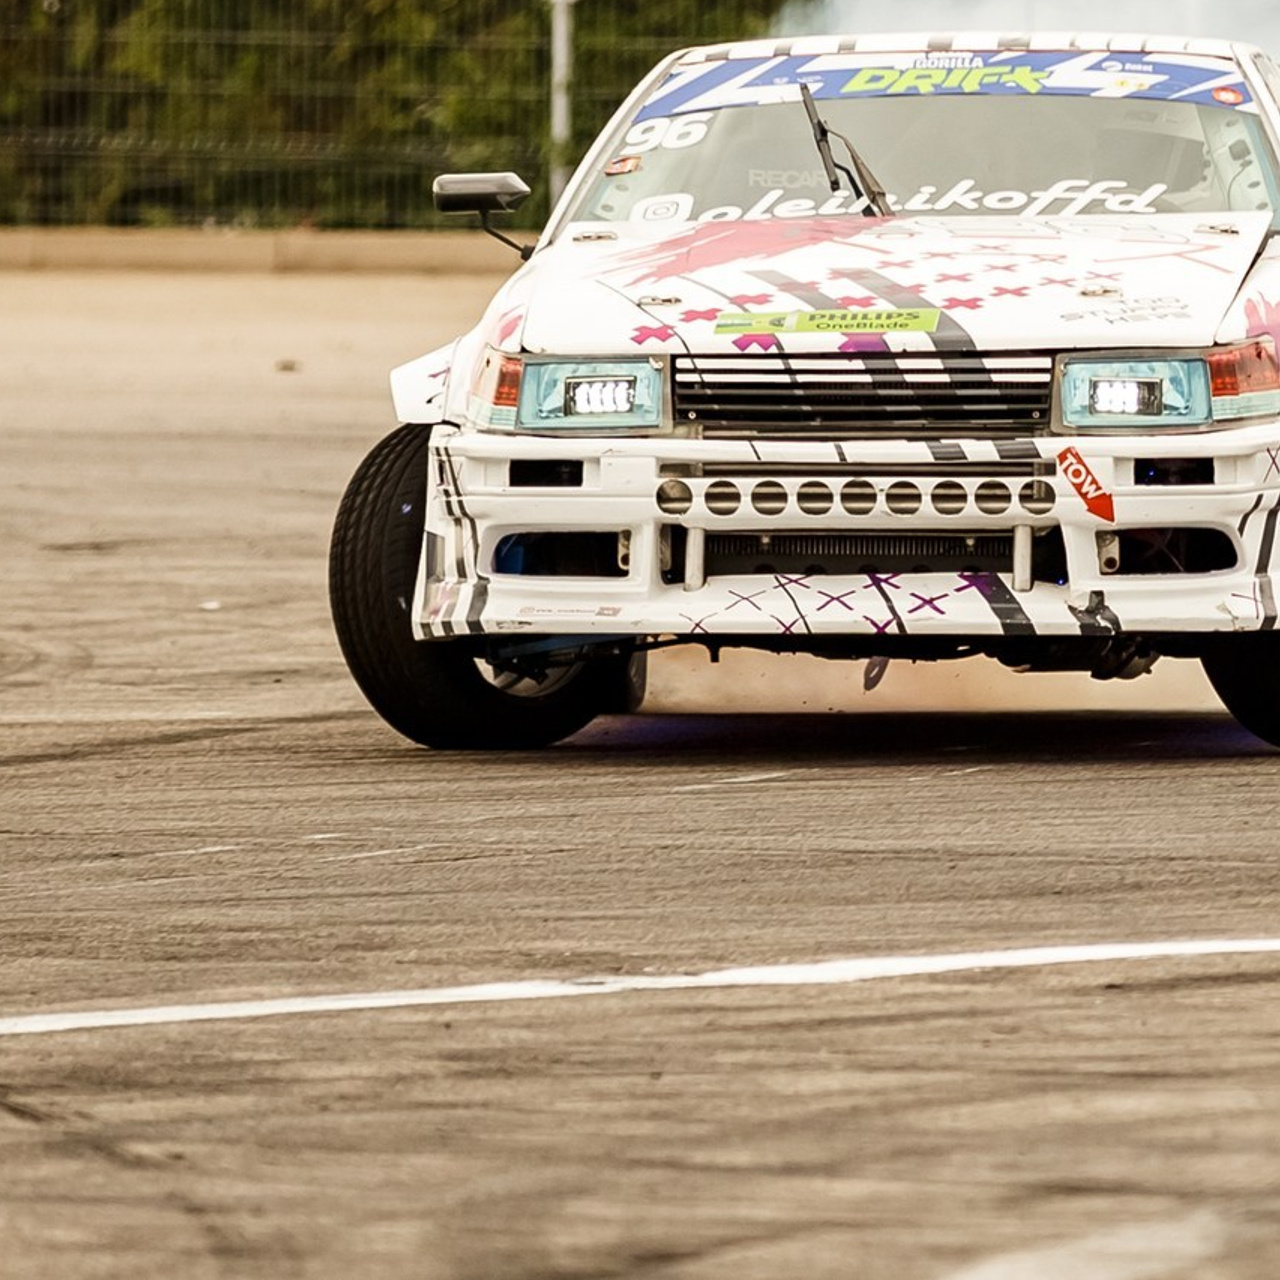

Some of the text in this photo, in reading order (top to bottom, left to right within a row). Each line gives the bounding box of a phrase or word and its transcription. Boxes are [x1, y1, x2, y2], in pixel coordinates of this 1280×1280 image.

[914, 56, 985, 69] GORILLA
[620, 112, 714, 155] 96
[749, 169, 847, 187] RECAR
[807, 311, 921, 322] PHILIPS
[815, 321, 910, 330] OneBlade
[1060, 452, 1105, 500] TOW
